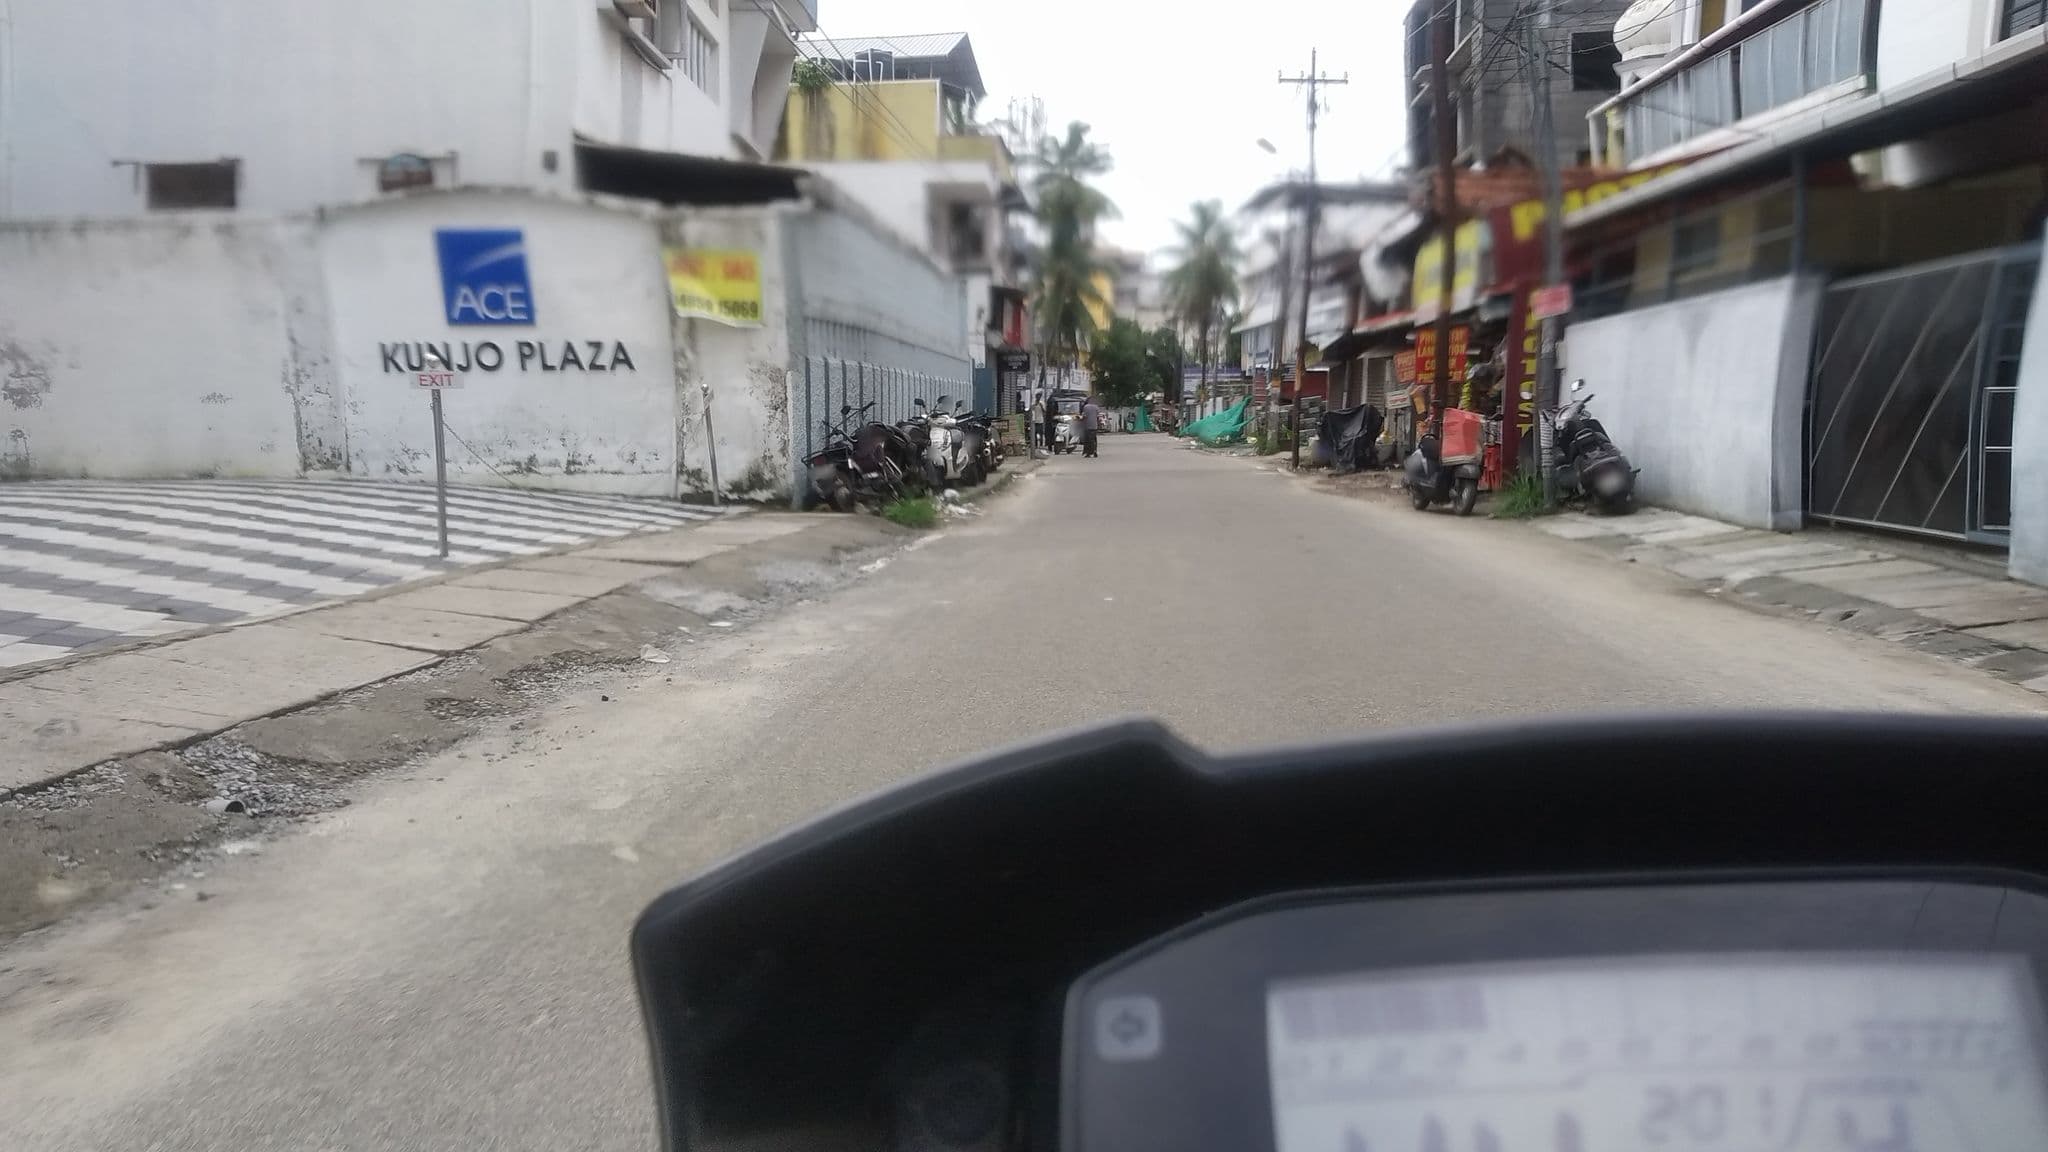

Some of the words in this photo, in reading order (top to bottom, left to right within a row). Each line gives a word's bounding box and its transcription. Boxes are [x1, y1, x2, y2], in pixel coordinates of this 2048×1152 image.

[452, 286, 528, 320] ACE
[379, 340, 505, 373] KUNJO
[516, 340, 637, 372] PLAZA
[418, 374, 455, 387] EXIT
